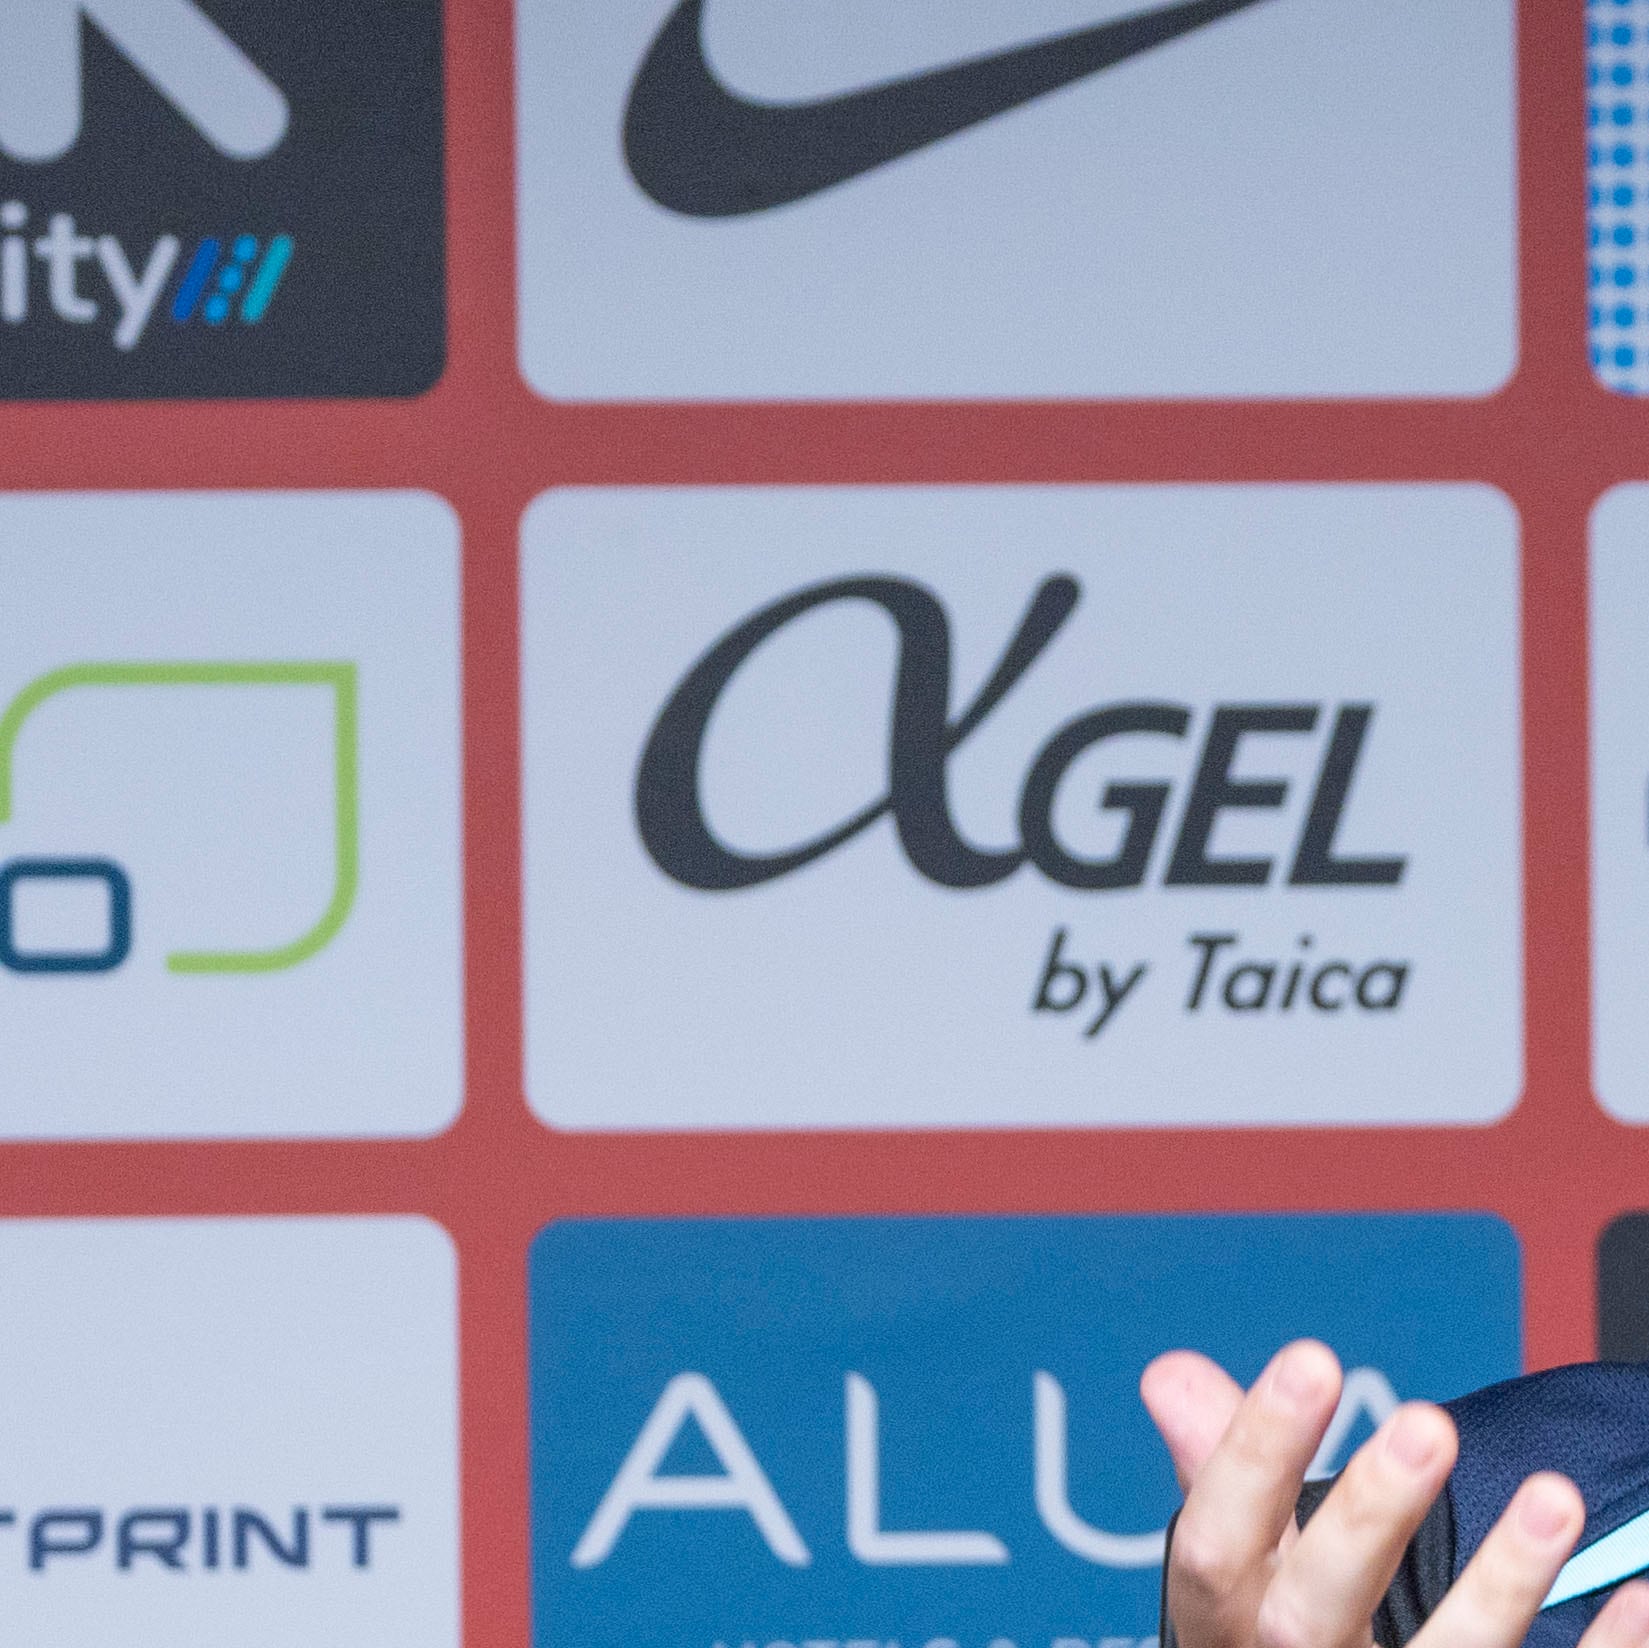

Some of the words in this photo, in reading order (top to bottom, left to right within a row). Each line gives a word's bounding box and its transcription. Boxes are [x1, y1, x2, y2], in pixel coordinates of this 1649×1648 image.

[1031, 927, 1147, 1040] by
[1185, 934, 1411, 1014] Taica
[0, 1505, 402, 1572] PRINT
